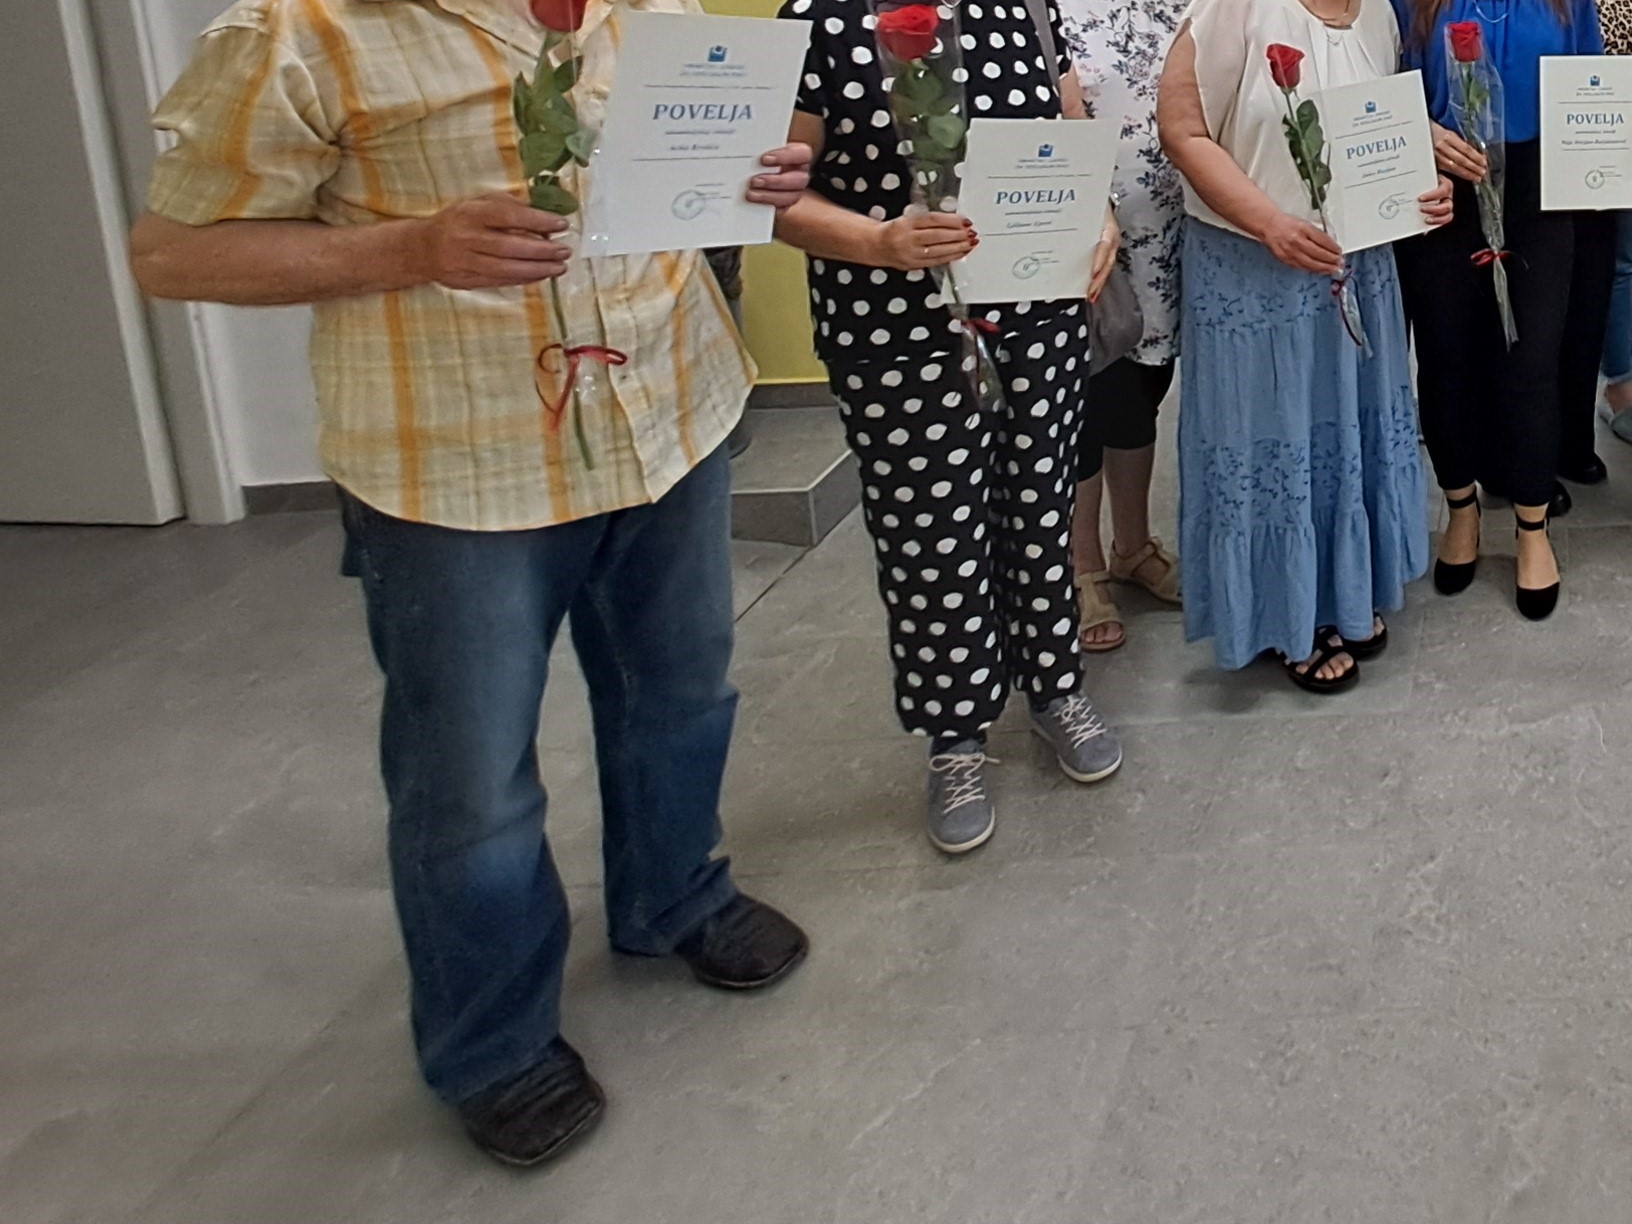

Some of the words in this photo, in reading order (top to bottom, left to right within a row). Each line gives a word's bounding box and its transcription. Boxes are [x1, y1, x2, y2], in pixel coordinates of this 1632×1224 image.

[652, 103, 753, 123] POVELJA
[1566, 113, 1625, 126] POVELJA
[1346, 135, 1407, 160] POVELJA
[995, 189, 1076, 205] POVELJA
